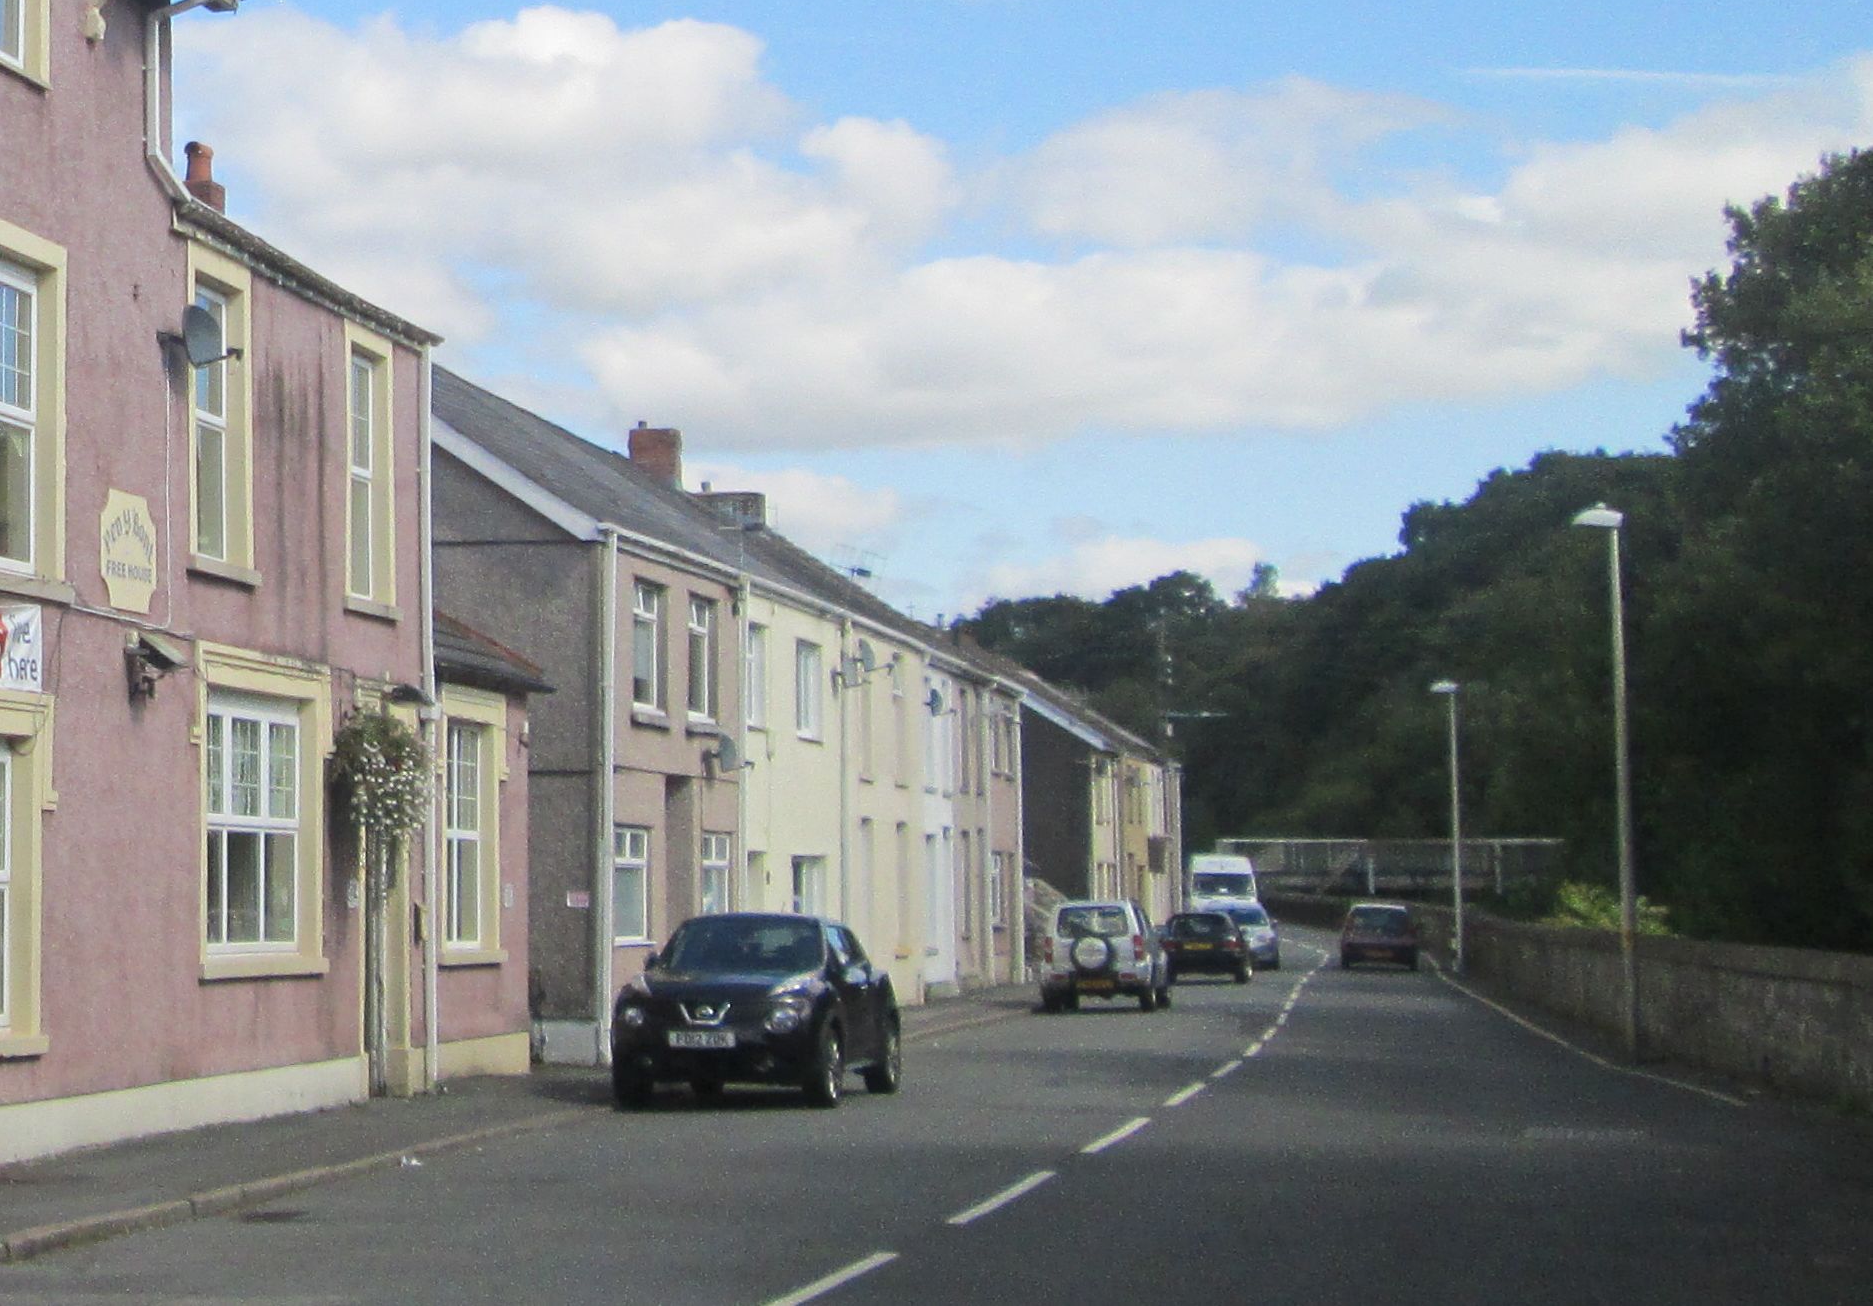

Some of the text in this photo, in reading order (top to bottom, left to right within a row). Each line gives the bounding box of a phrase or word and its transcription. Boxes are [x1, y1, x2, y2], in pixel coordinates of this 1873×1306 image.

[106, 559, 152, 584] FREE HOUSE
[7, 647, 39, 682] here
